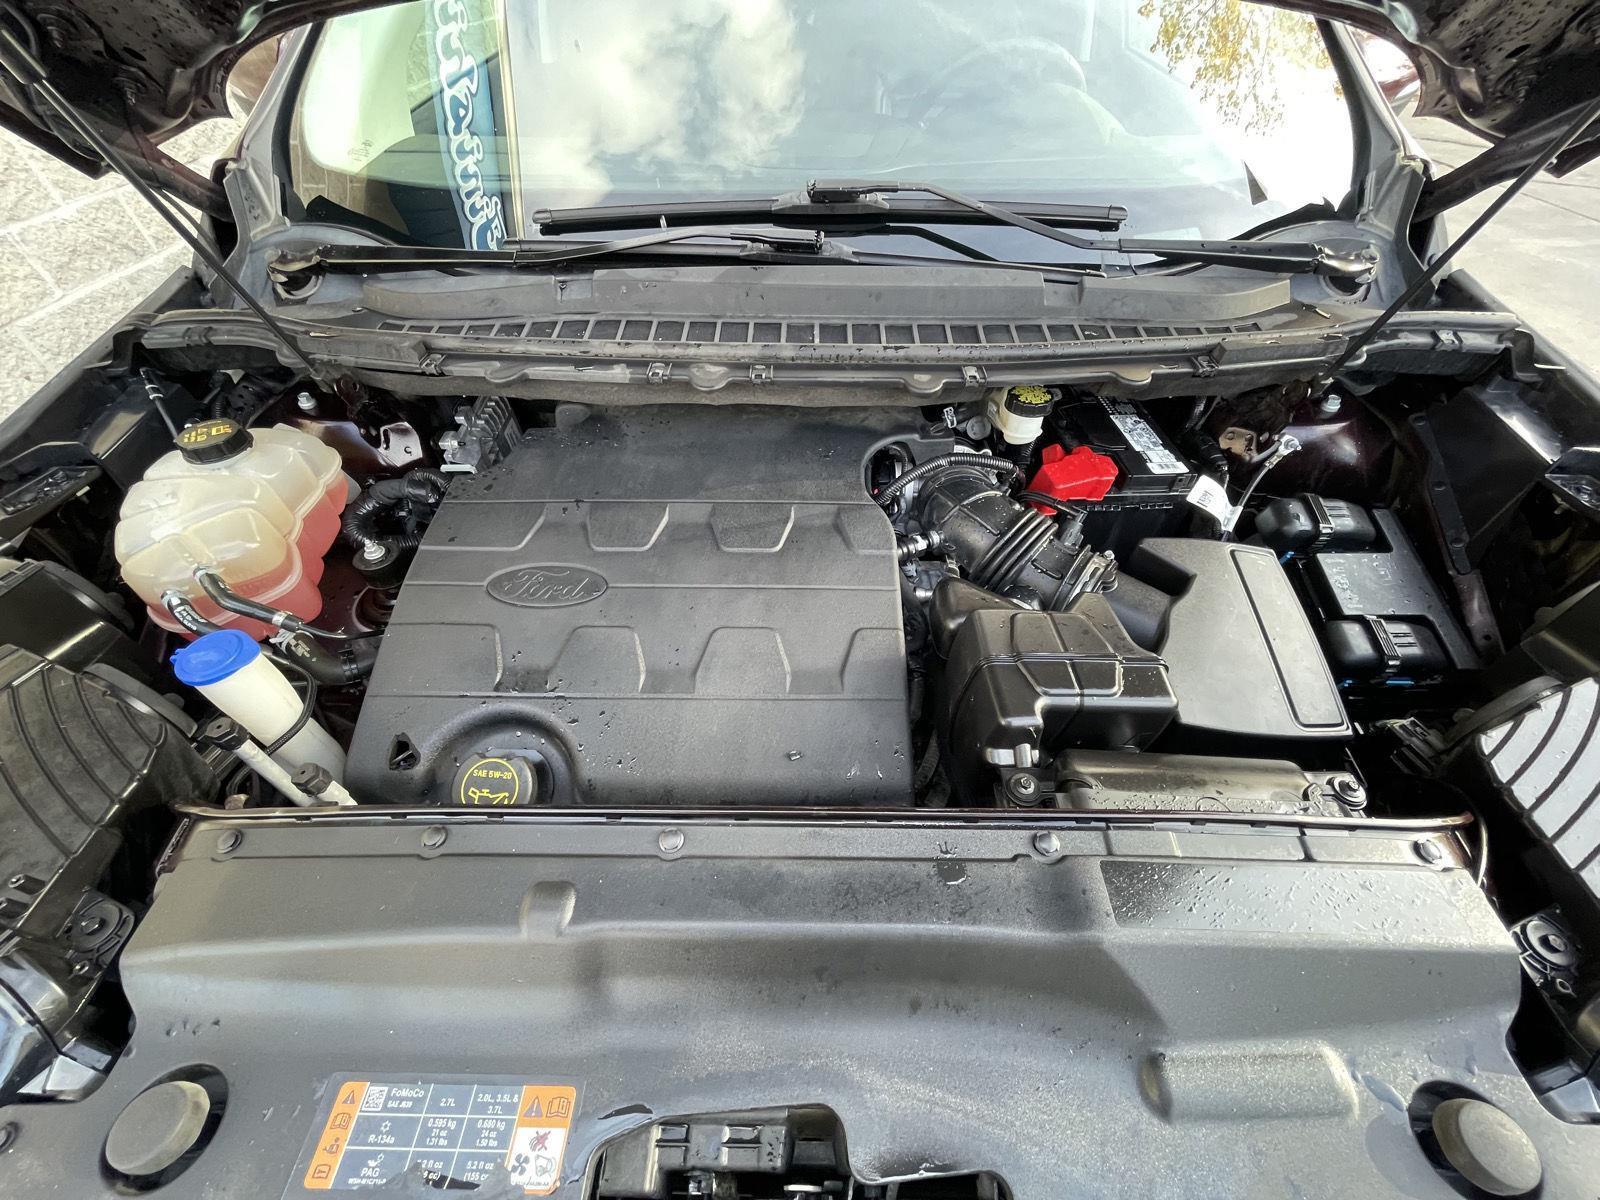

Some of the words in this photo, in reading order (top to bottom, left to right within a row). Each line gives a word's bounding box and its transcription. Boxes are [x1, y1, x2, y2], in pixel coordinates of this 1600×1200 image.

[501, 569, 589, 600] Ford
[473, 769, 488, 778] SAE
[488, 770, 512, 780] 5W-20
[391, 1088, 425, 1098] FoMoCo
[440, 1098, 456, 1107] 2.7L
[488, 1105, 503, 1114] 3.7L
[428, 1118, 447, 1128] 0.595
[447, 1119, 457, 1130] kg
[496, 1119, 506, 1130] kg
[368, 1134, 395, 1145] R-134a
[485, 1162, 494, 1170] oz
[361, 1168, 380, 1177] PAG
